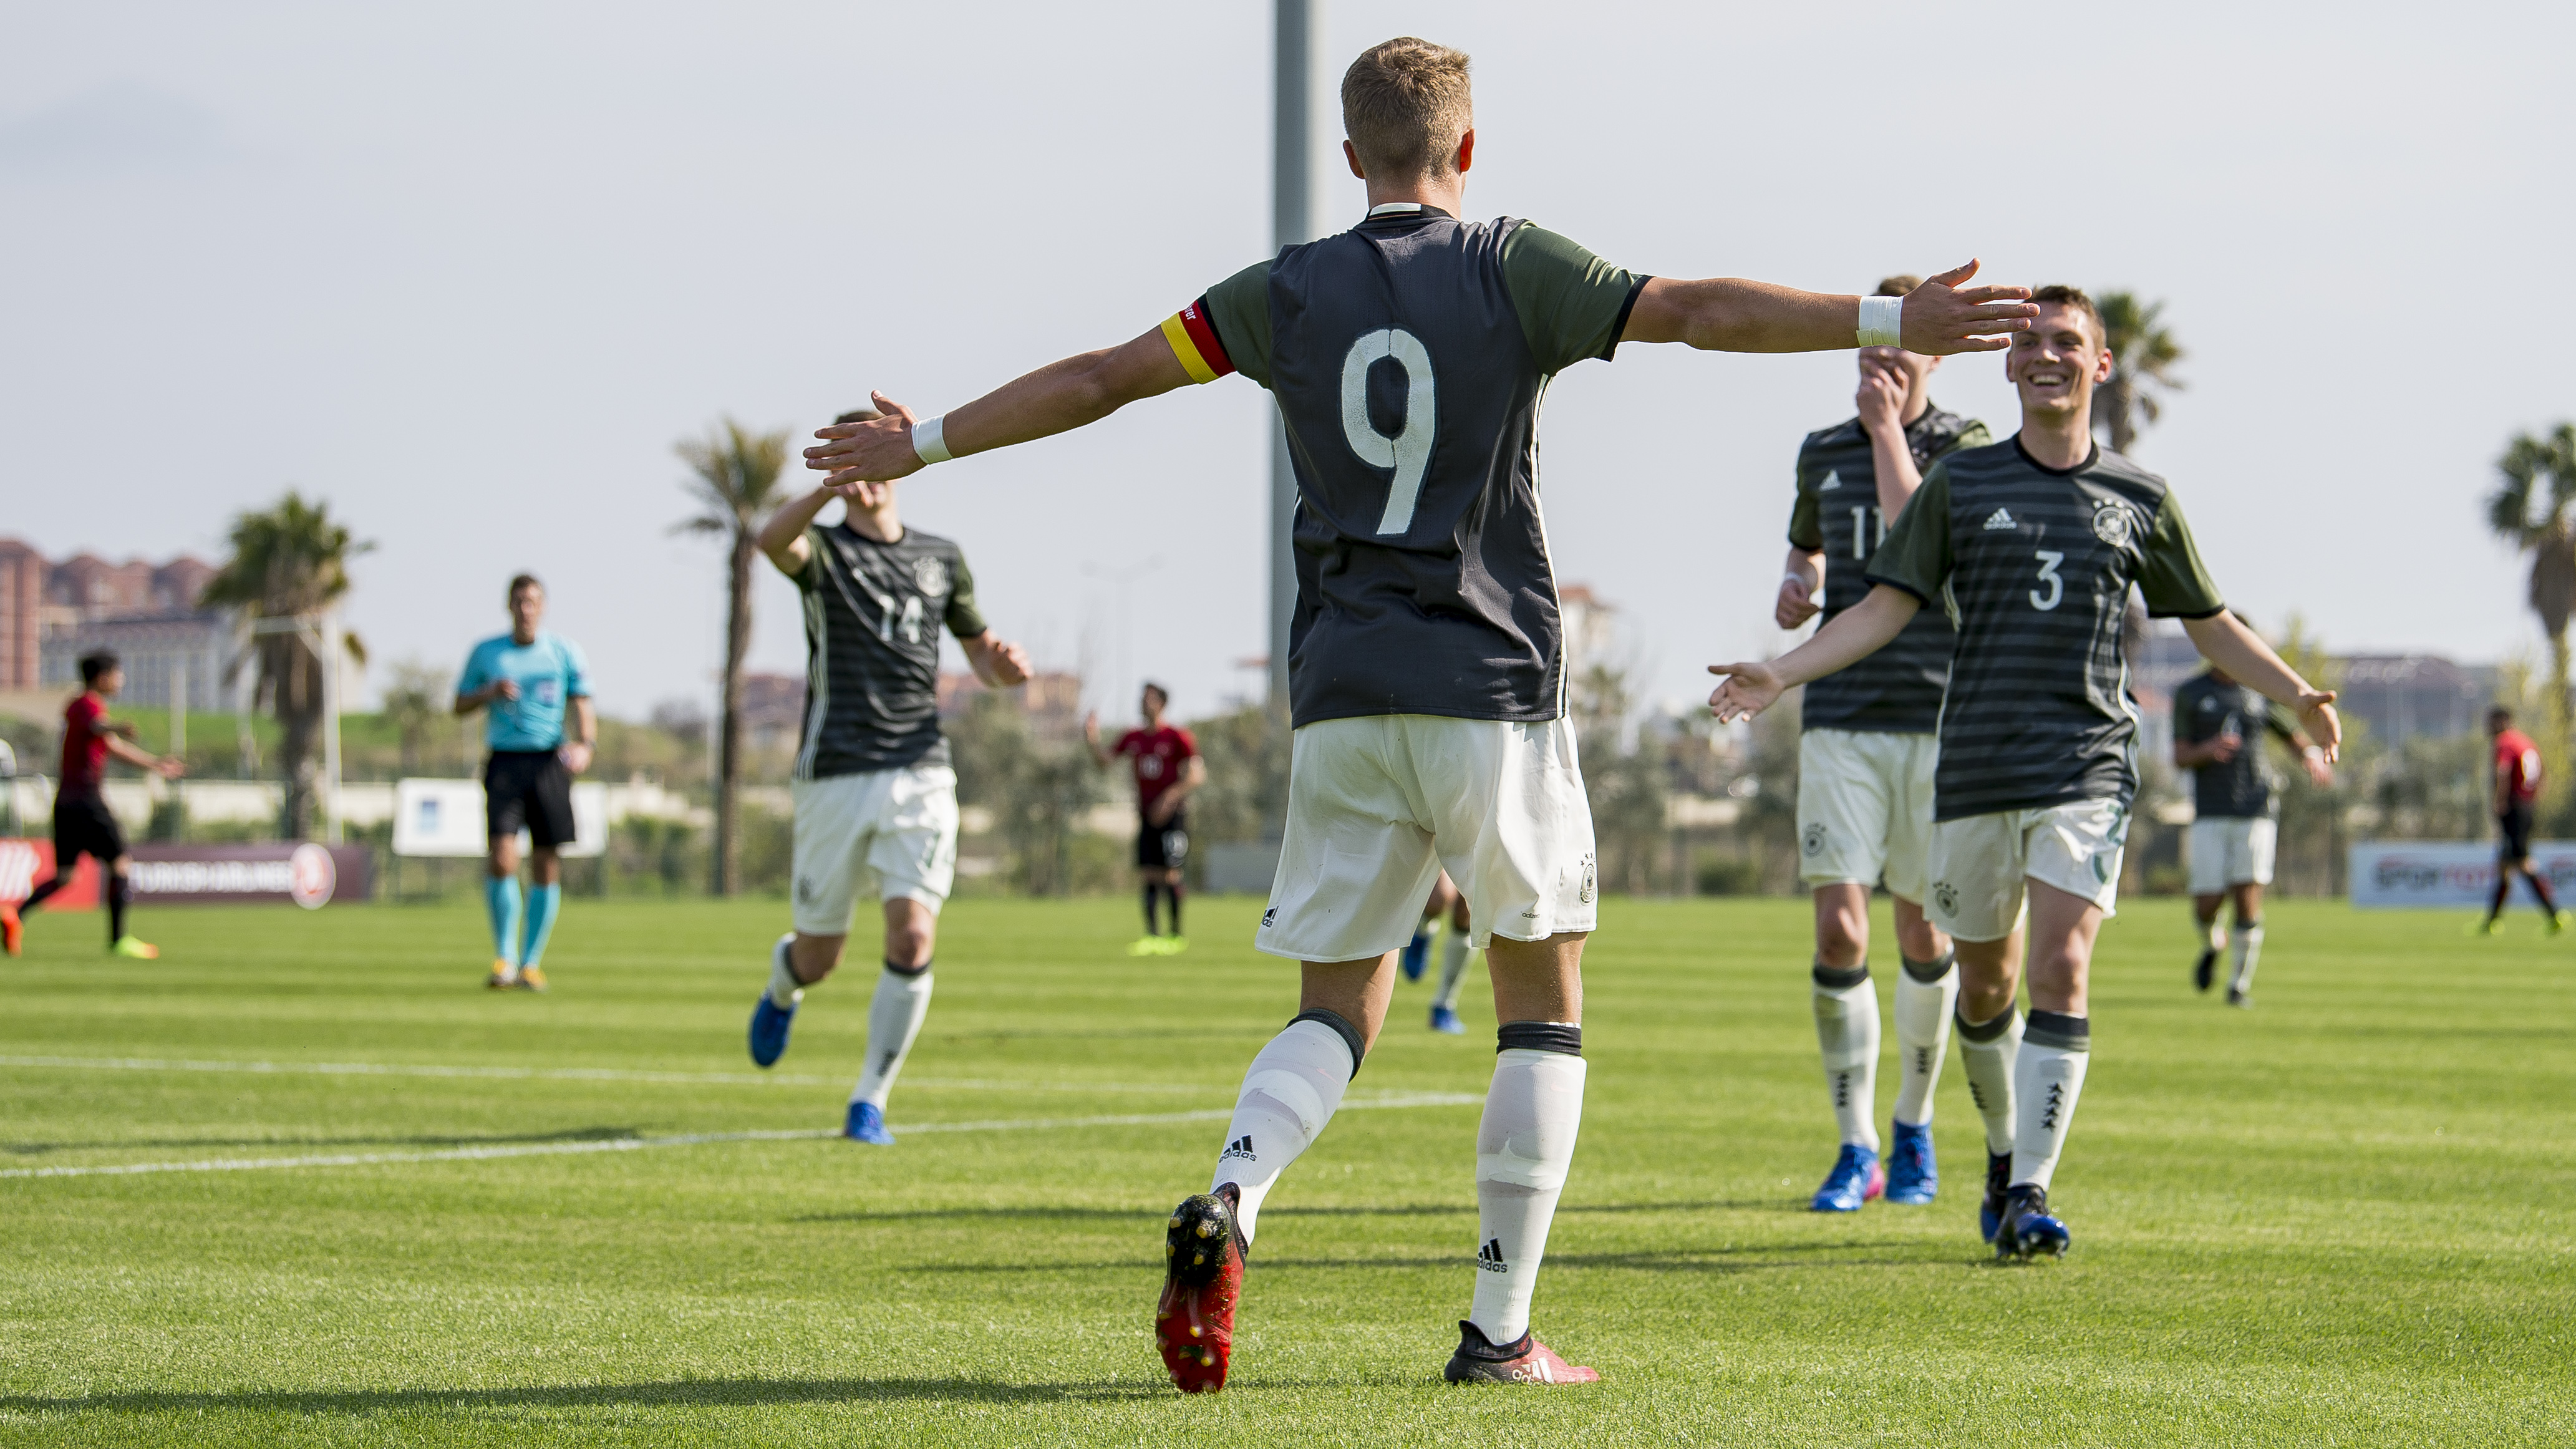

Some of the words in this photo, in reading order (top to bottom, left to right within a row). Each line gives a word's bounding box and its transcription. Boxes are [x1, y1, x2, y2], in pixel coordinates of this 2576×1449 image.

[1342, 329, 1435, 535] 9
[1850, 505, 1886, 560] 11
[2029, 550, 2063, 610] 3
[1219, 1149, 1257, 1163] adidas
